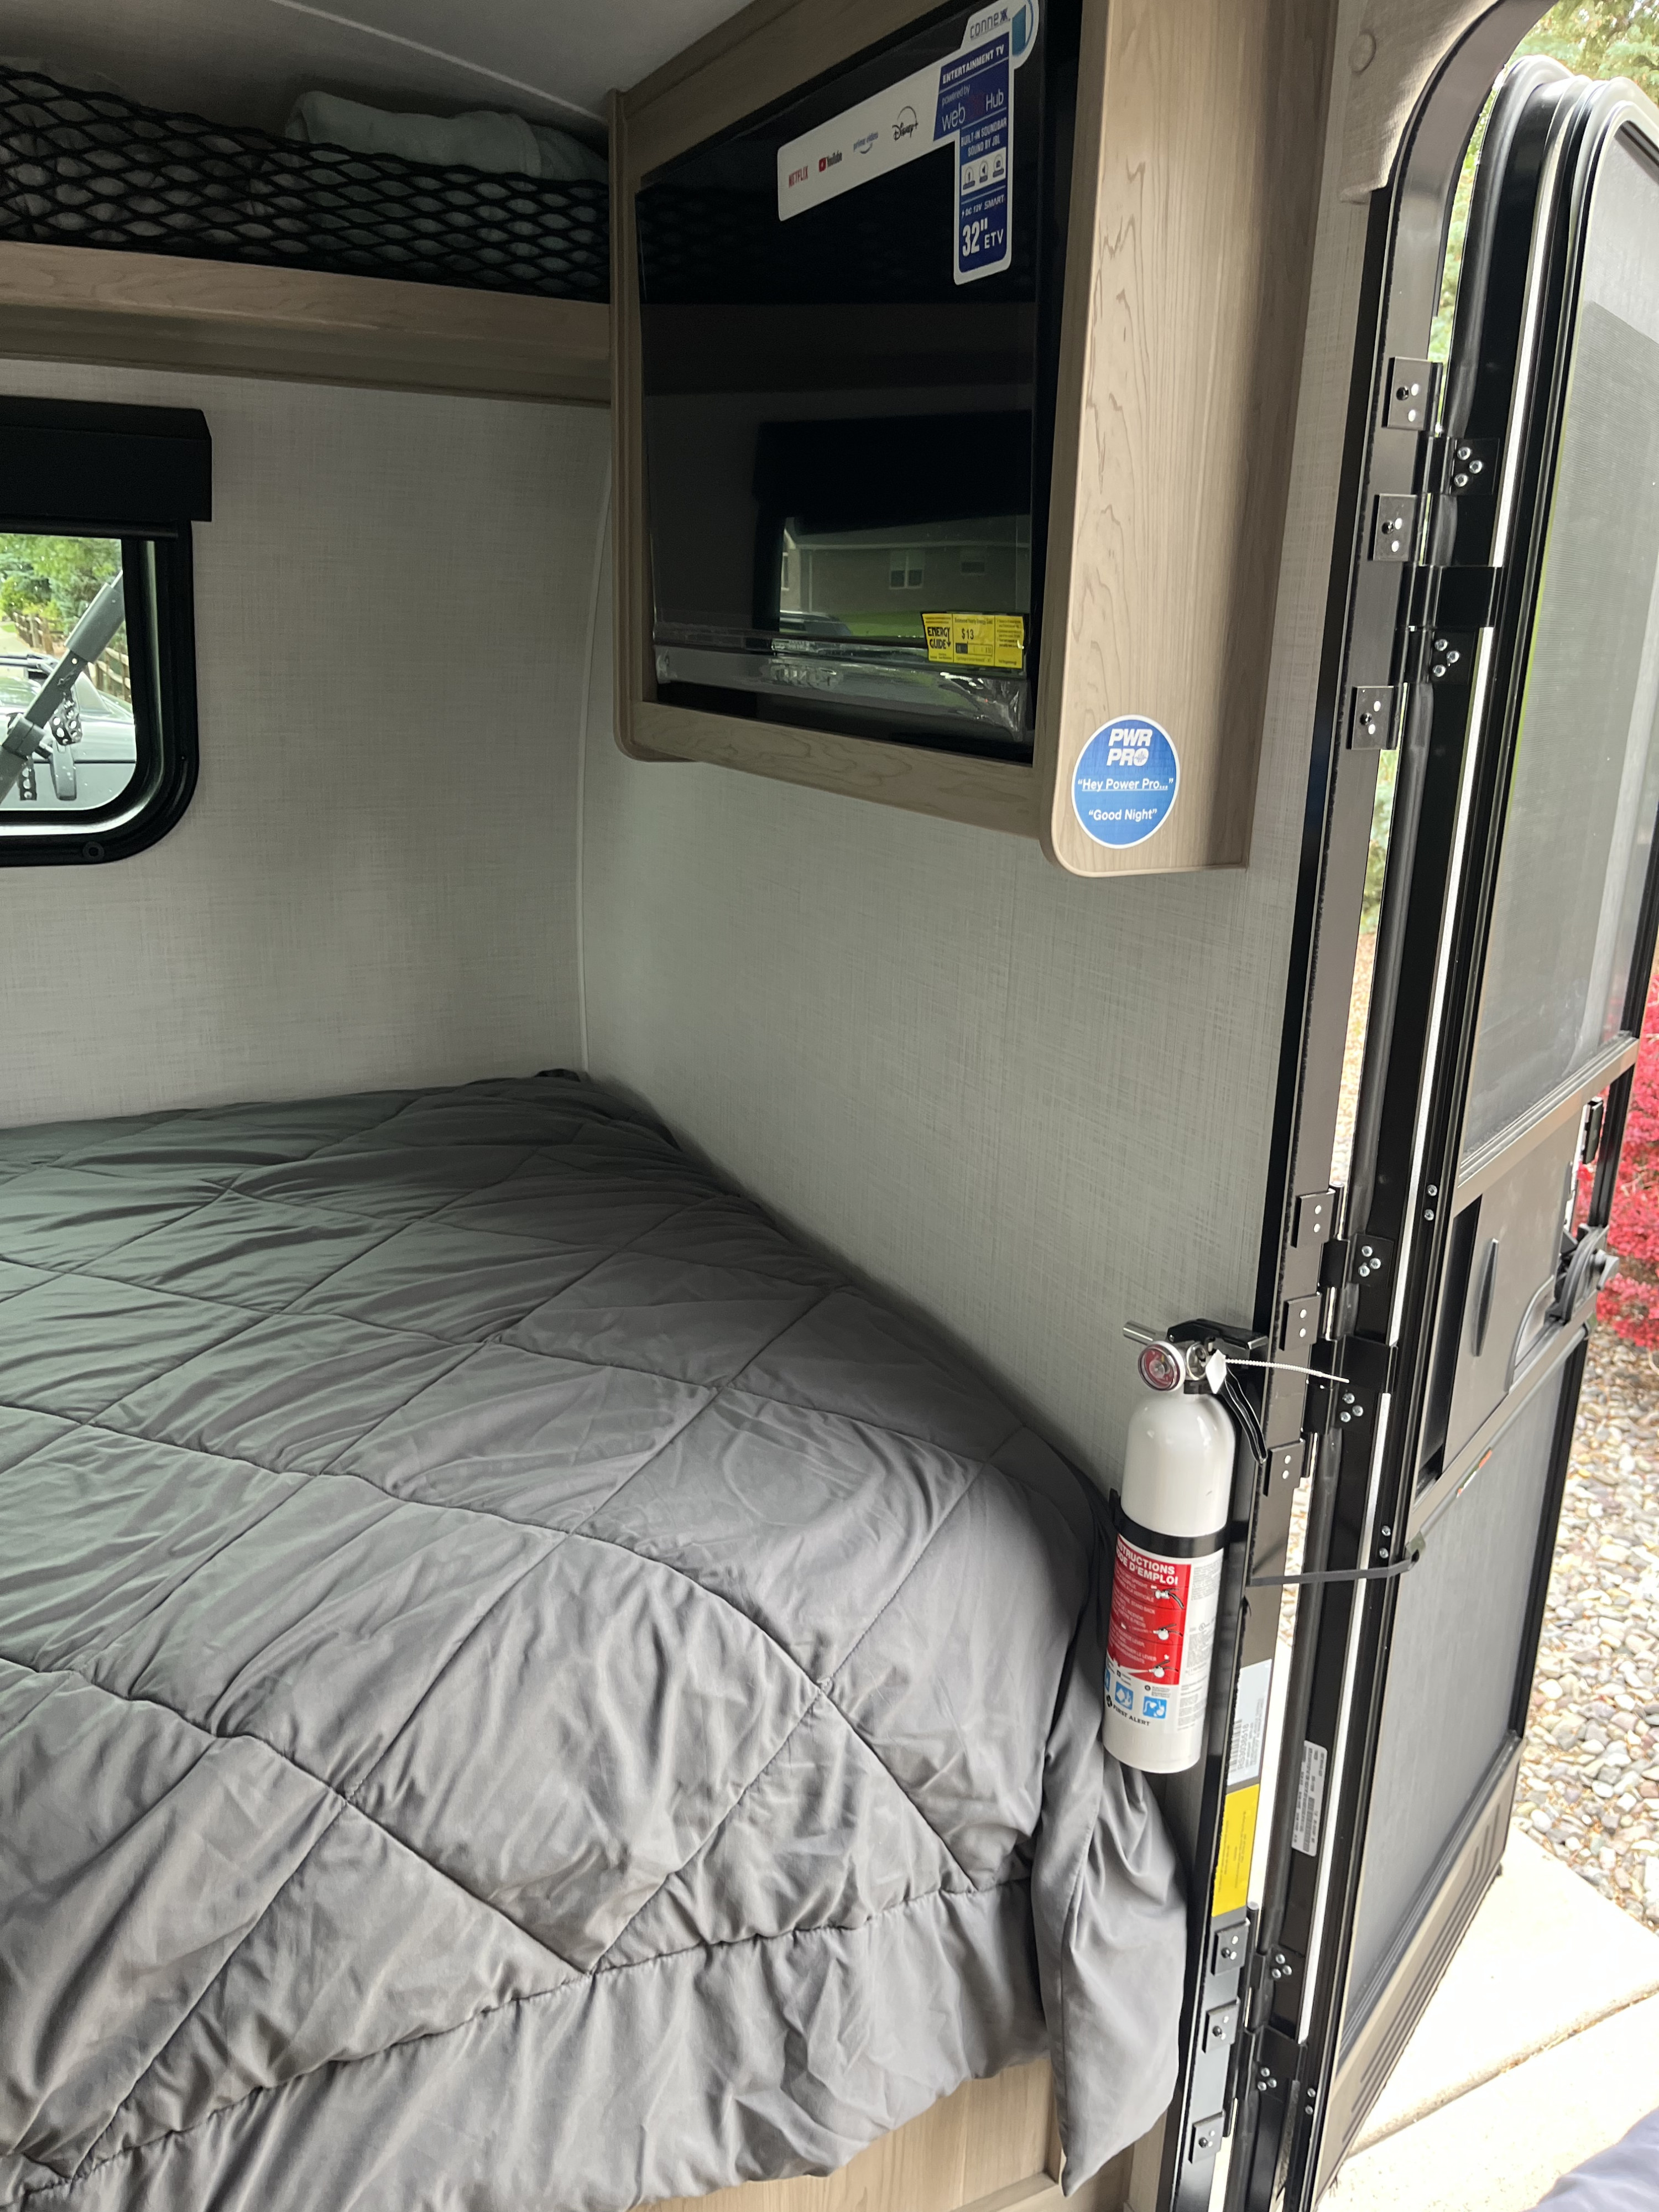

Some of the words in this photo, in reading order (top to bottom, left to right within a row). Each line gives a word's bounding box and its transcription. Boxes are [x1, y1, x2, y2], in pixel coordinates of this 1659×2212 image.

[942, 49, 994, 84] ENTERTAINMENT
[995, 44, 1004, 57] TV
[942, 87, 963, 108] powered
[963, 84, 971, 96] by
[986, 88, 1004, 112] Hub
[981, 117, 1007, 138] SOUNDBAR
[968, 141, 984, 157] SOUND
[984, 137, 991, 149] BY
[789, 165, 808, 188] NETFLIX
[973, 202, 983, 213] 12V
[984, 194, 1004, 210] SMART
[962, 217, 988, 257] 32"
[984, 228, 1004, 249] ETV
[927, 626, 951, 637] ENERGY
[930, 638, 946, 650] GUIDE
[1108, 728, 1153, 747] PWR
[1107, 748, 1149, 766] PRO
[1106, 779, 1139, 790] Power
[1129, 1562, 1178, 1585] D'EMPLOI
[1113, 1704, 1128, 1718] FIRST
[1129, 1715, 1150, 1726] ALERT
